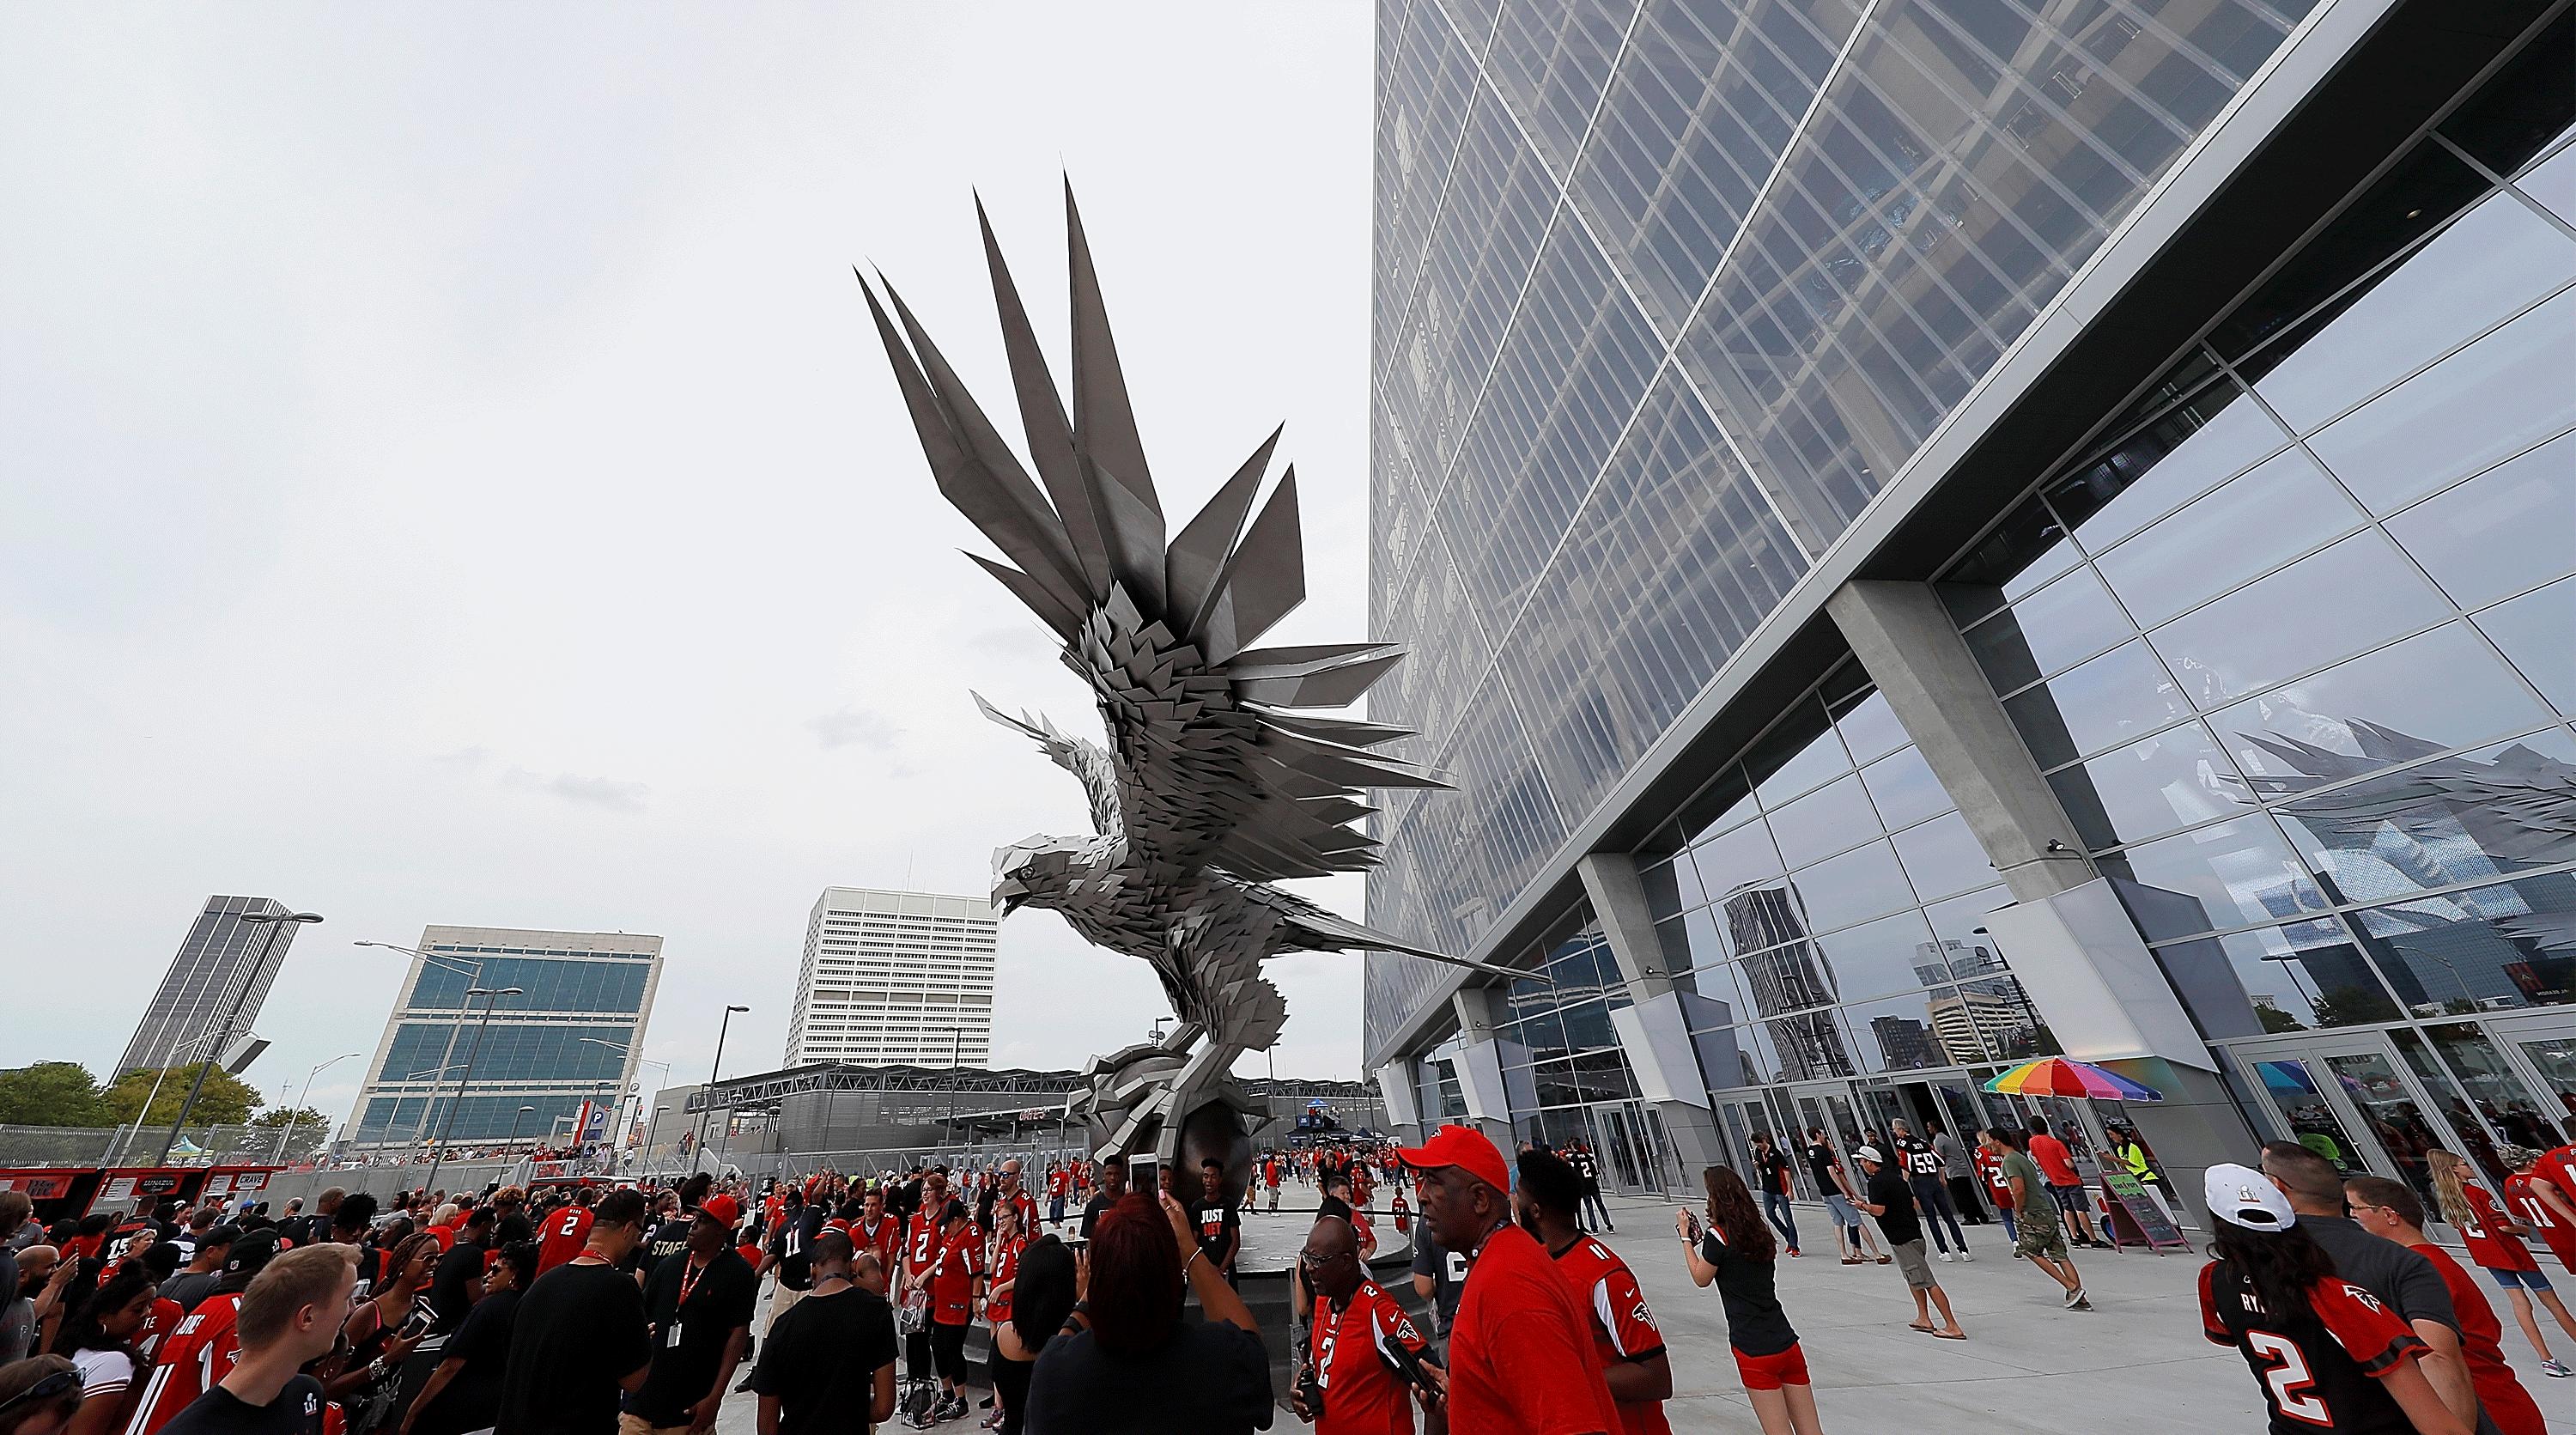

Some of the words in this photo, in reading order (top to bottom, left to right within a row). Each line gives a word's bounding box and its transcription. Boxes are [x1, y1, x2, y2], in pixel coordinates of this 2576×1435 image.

[593, 1114, 603, 1123] P
[1580, 1161, 1592, 1177] 2
[1912, 1153, 1937, 1174] 59
[240, 1175, 264, 1183] CRAVE
[1051, 1177, 1060, 1192] 2
[1988, 1166, 2008, 1187] 2
[756, 1200, 766, 1213] 2
[1200, 1208, 1224, 1223] JUST
[2518, 1197, 2555, 1227] 11
[560, 1215, 579, 1236] 2
[969, 1225, 978, 1237] 2
[1204, 1222, 1221, 1236] NET
[785, 1227, 801, 1258] 11
[914, 1232, 930, 1262] 2
[1589, 1243, 1610, 1260] 11
[936, 1247, 948, 1276] 2
[995, 1252, 1007, 1277] 2
[1364, 1285, 1378, 1298] 2
[1318, 1336, 1336, 1389] 2
[2246, 1329, 2335, 1429] 2
